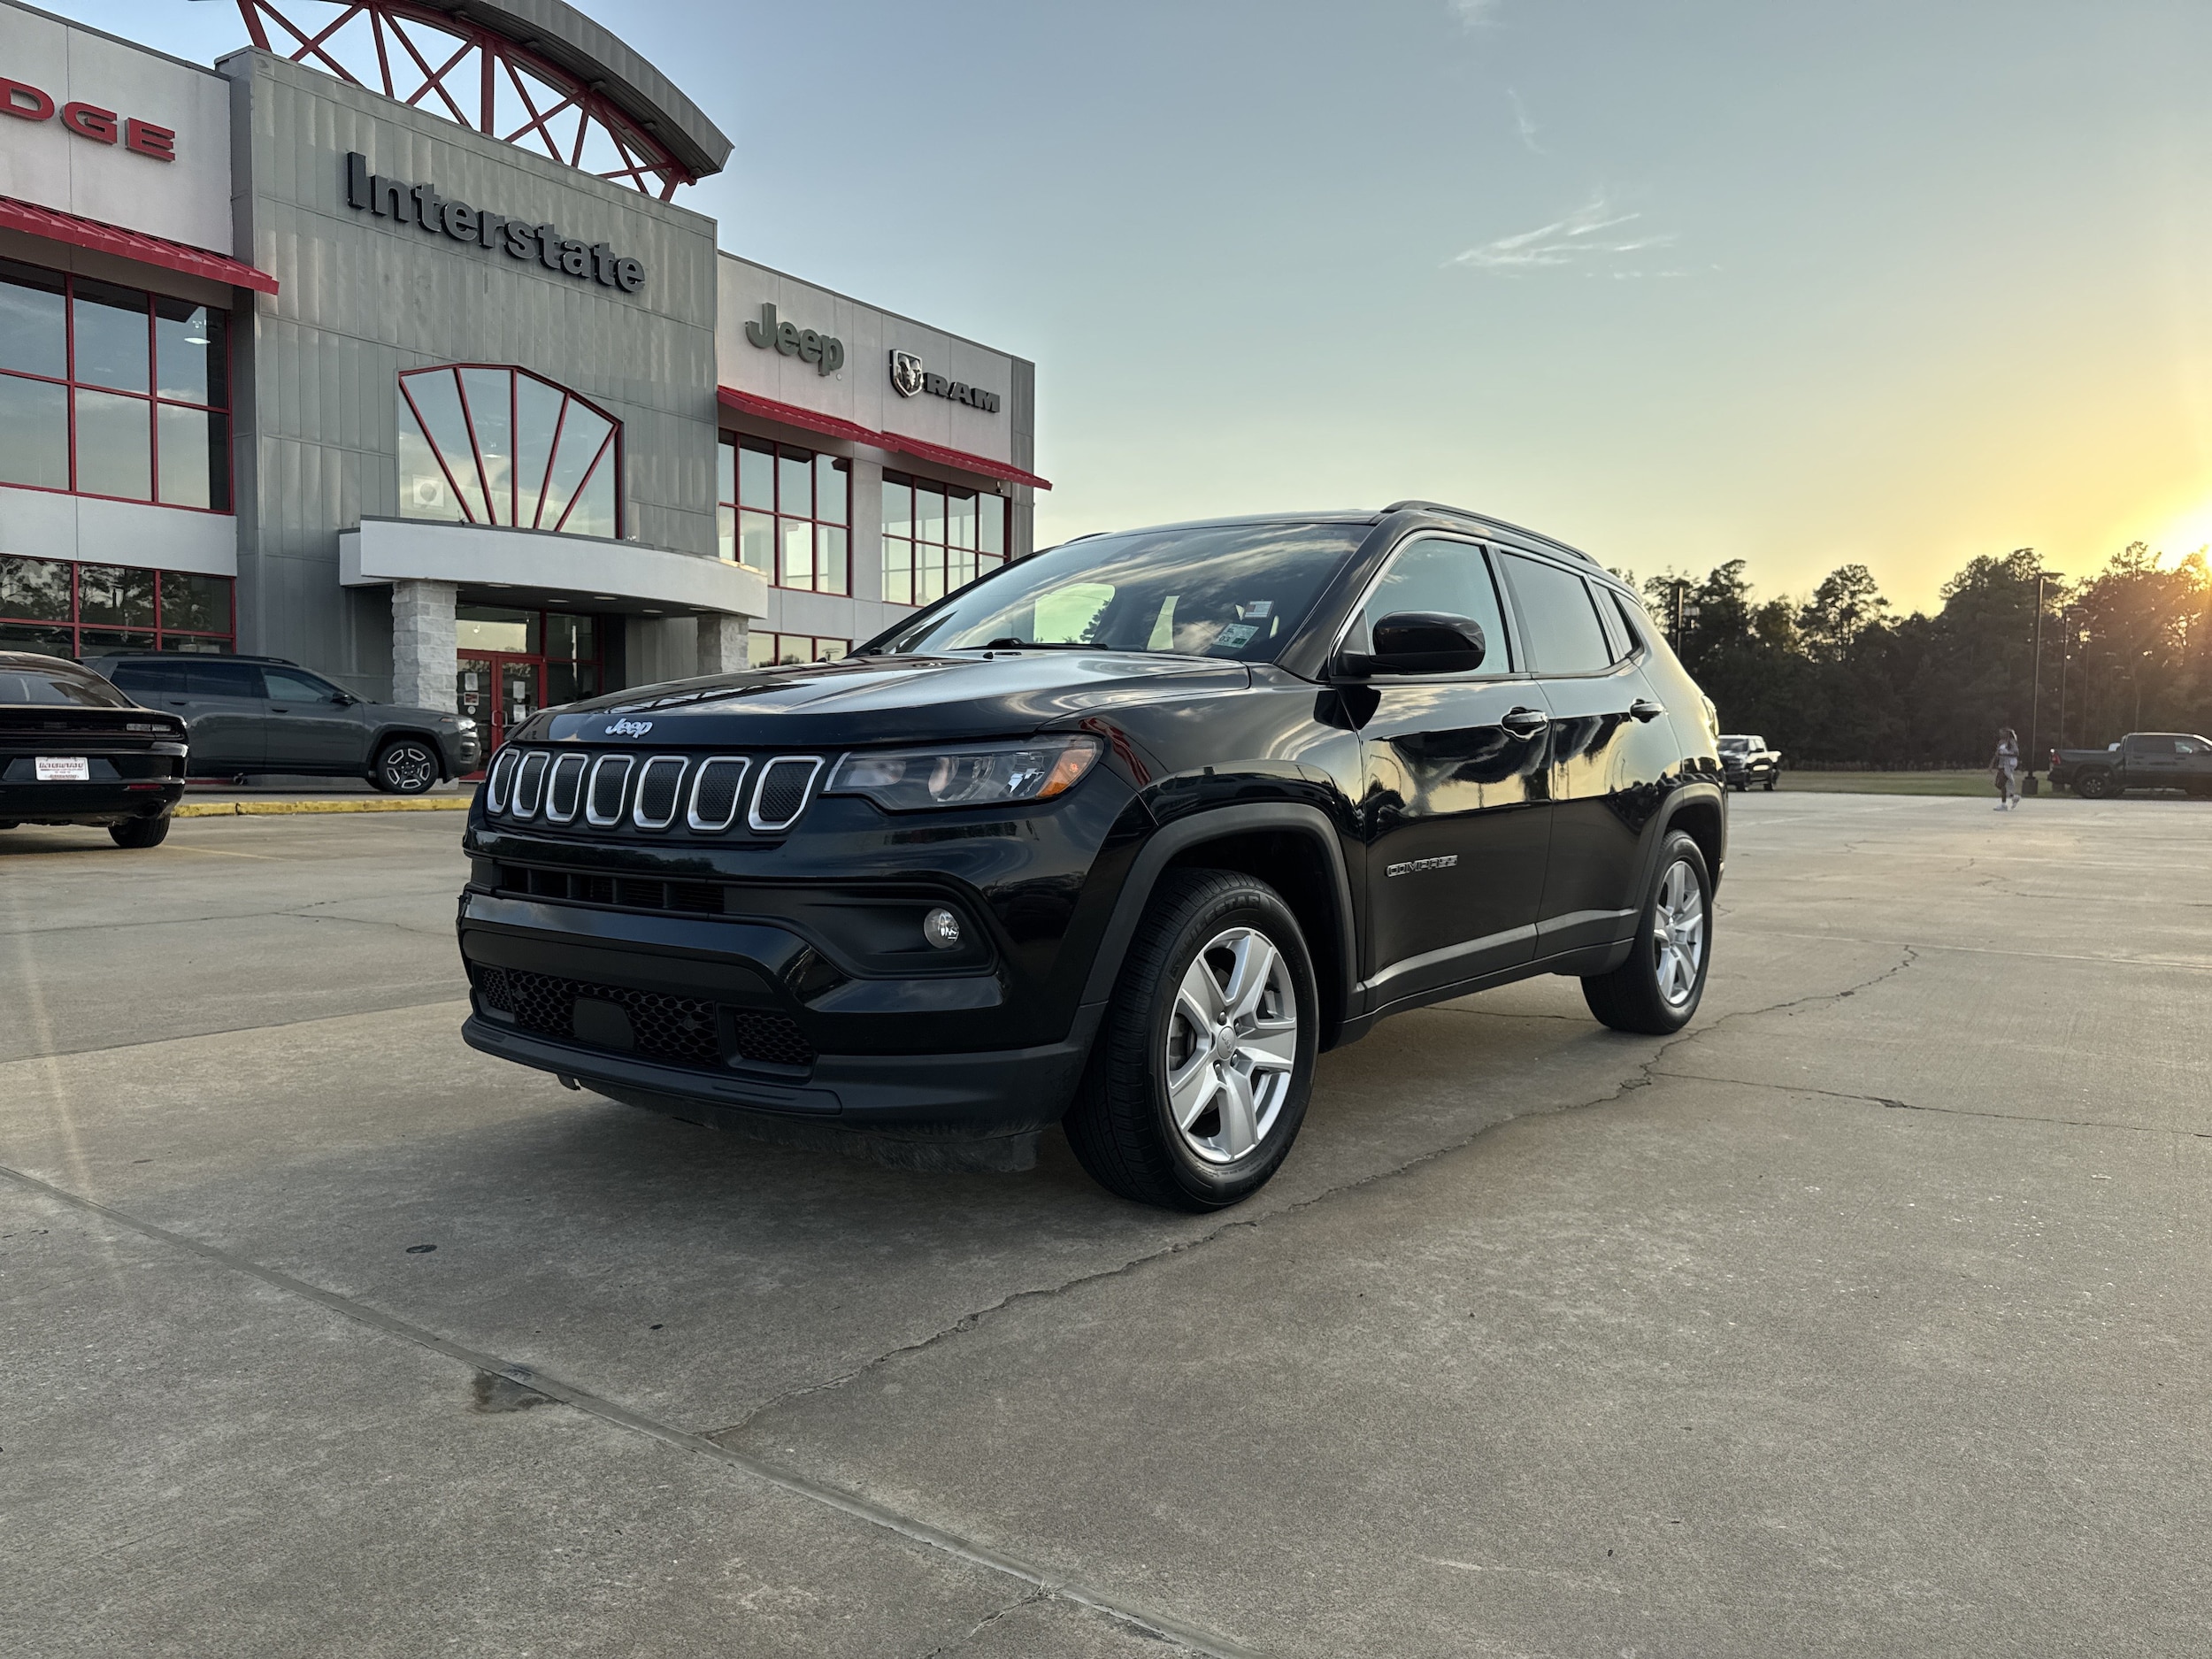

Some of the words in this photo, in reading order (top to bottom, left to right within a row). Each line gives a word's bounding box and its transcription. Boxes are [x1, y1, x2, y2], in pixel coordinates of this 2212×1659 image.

[348, 151, 646, 293] Interstate
[745, 302, 845, 377] Jeep
[924, 372, 1000, 412] RAM
[605, 718, 653, 739] Jeep
[1386, 854, 1458, 878] COMPASS
